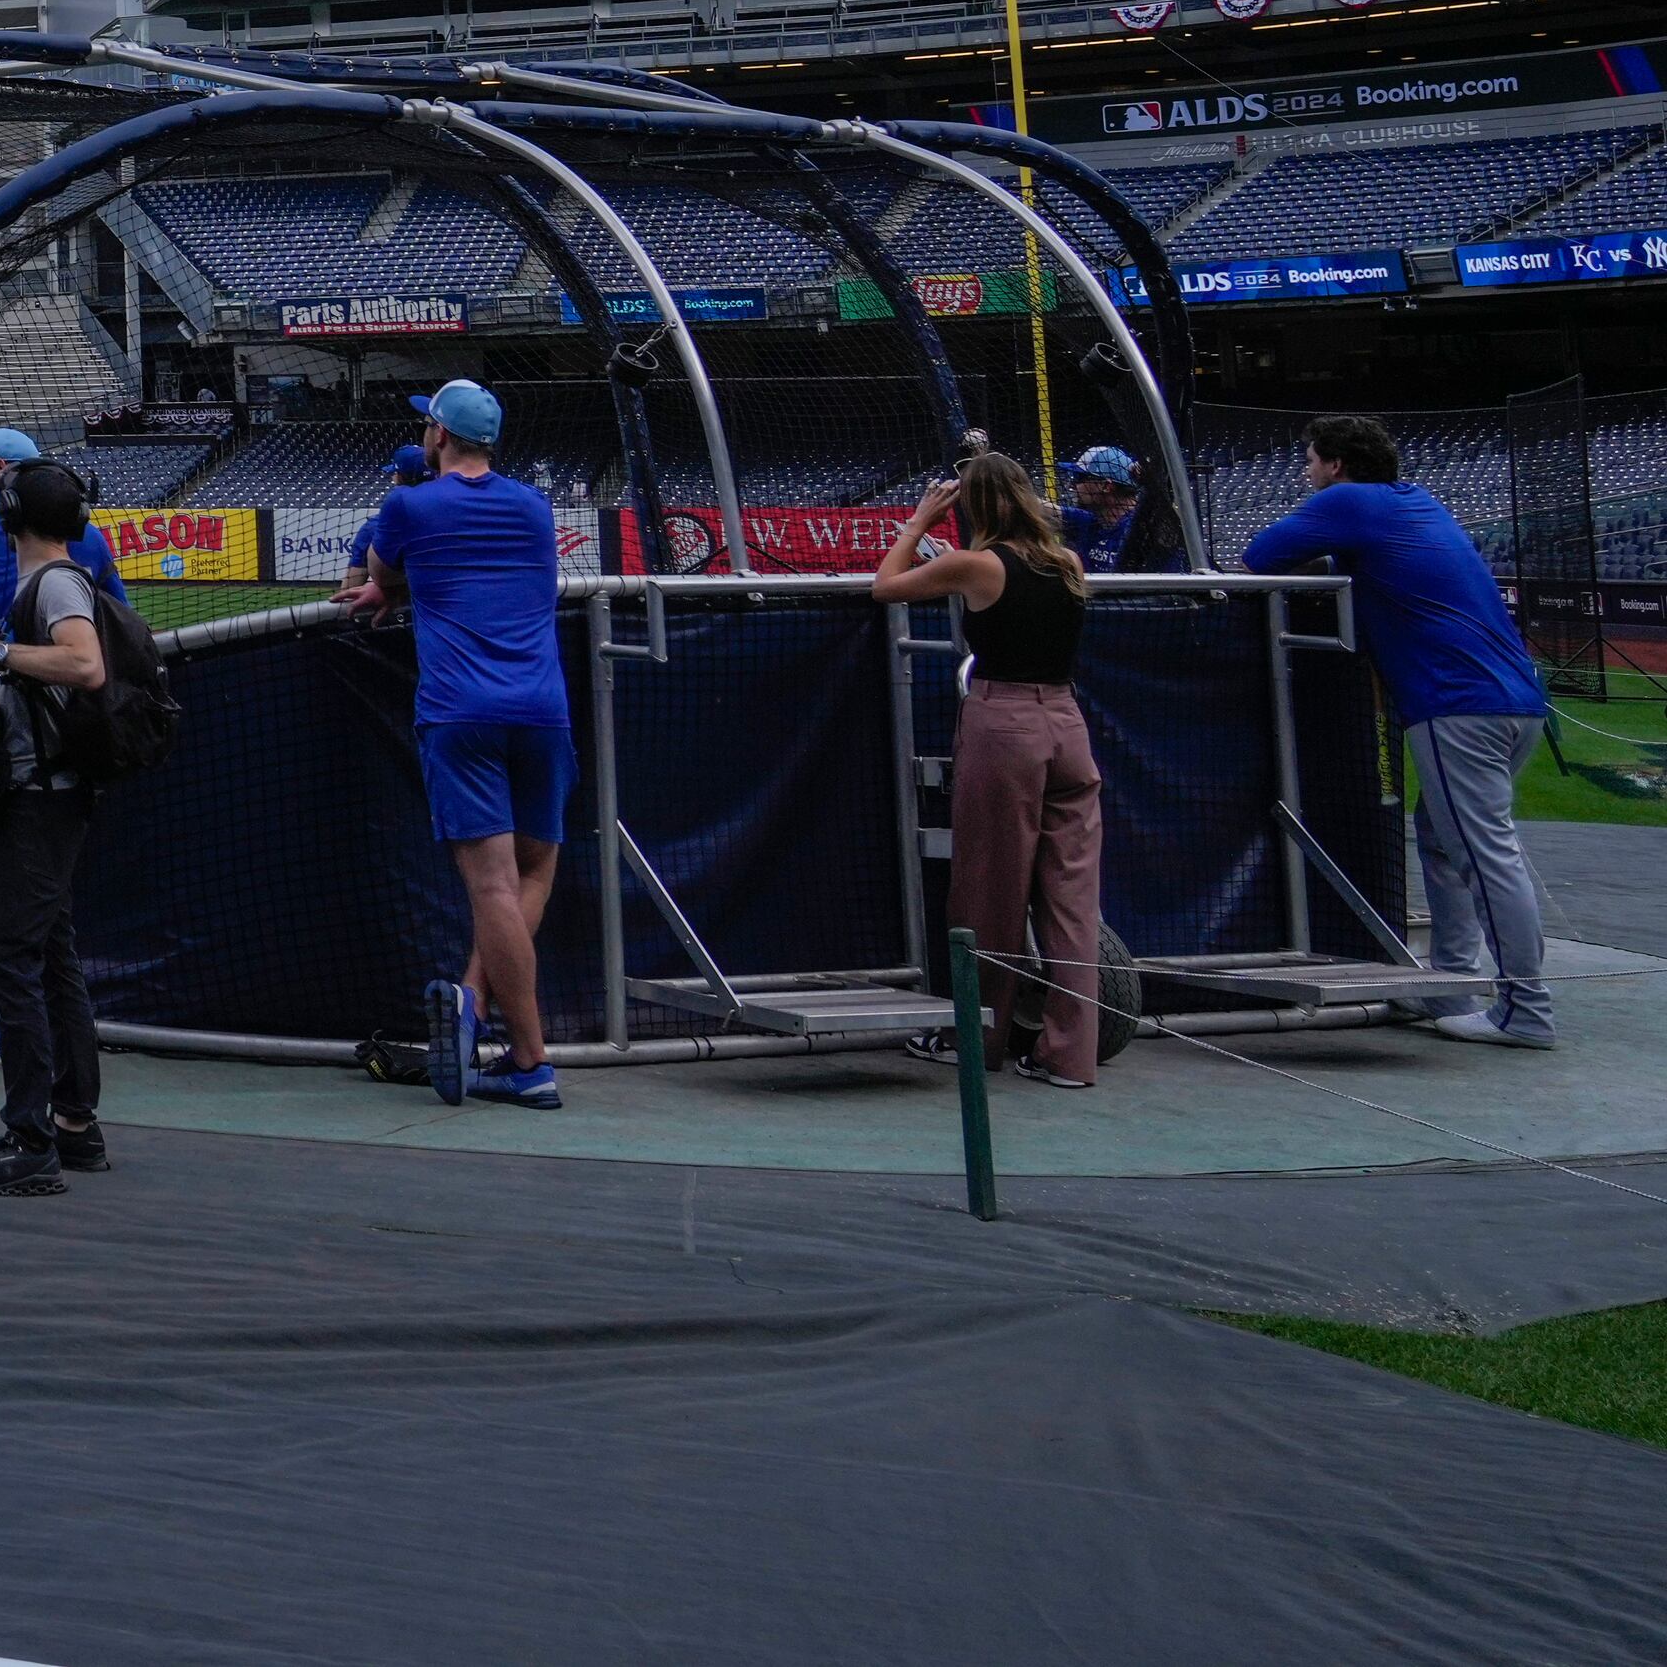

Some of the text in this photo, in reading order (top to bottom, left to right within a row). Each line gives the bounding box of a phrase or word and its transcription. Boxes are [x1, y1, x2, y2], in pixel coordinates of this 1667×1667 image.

[1168, 75, 1518, 130] ALDS 2024 Booking.com
[1342, 119, 1480, 146] CLUBHOUSE
[1465, 254, 1511, 272] KANSAS
[1514, 252, 1550, 270] CITY
[1610, 248, 1631, 263] vs
[1234, 265, 1388, 286] 2024 Booking.com
[282, 295, 462, 325] Parts Authority
[685, 299, 753, 310] Booking.com
[282, 538, 351, 553] BANK
[1621, 599, 1659, 612] Booking.com
